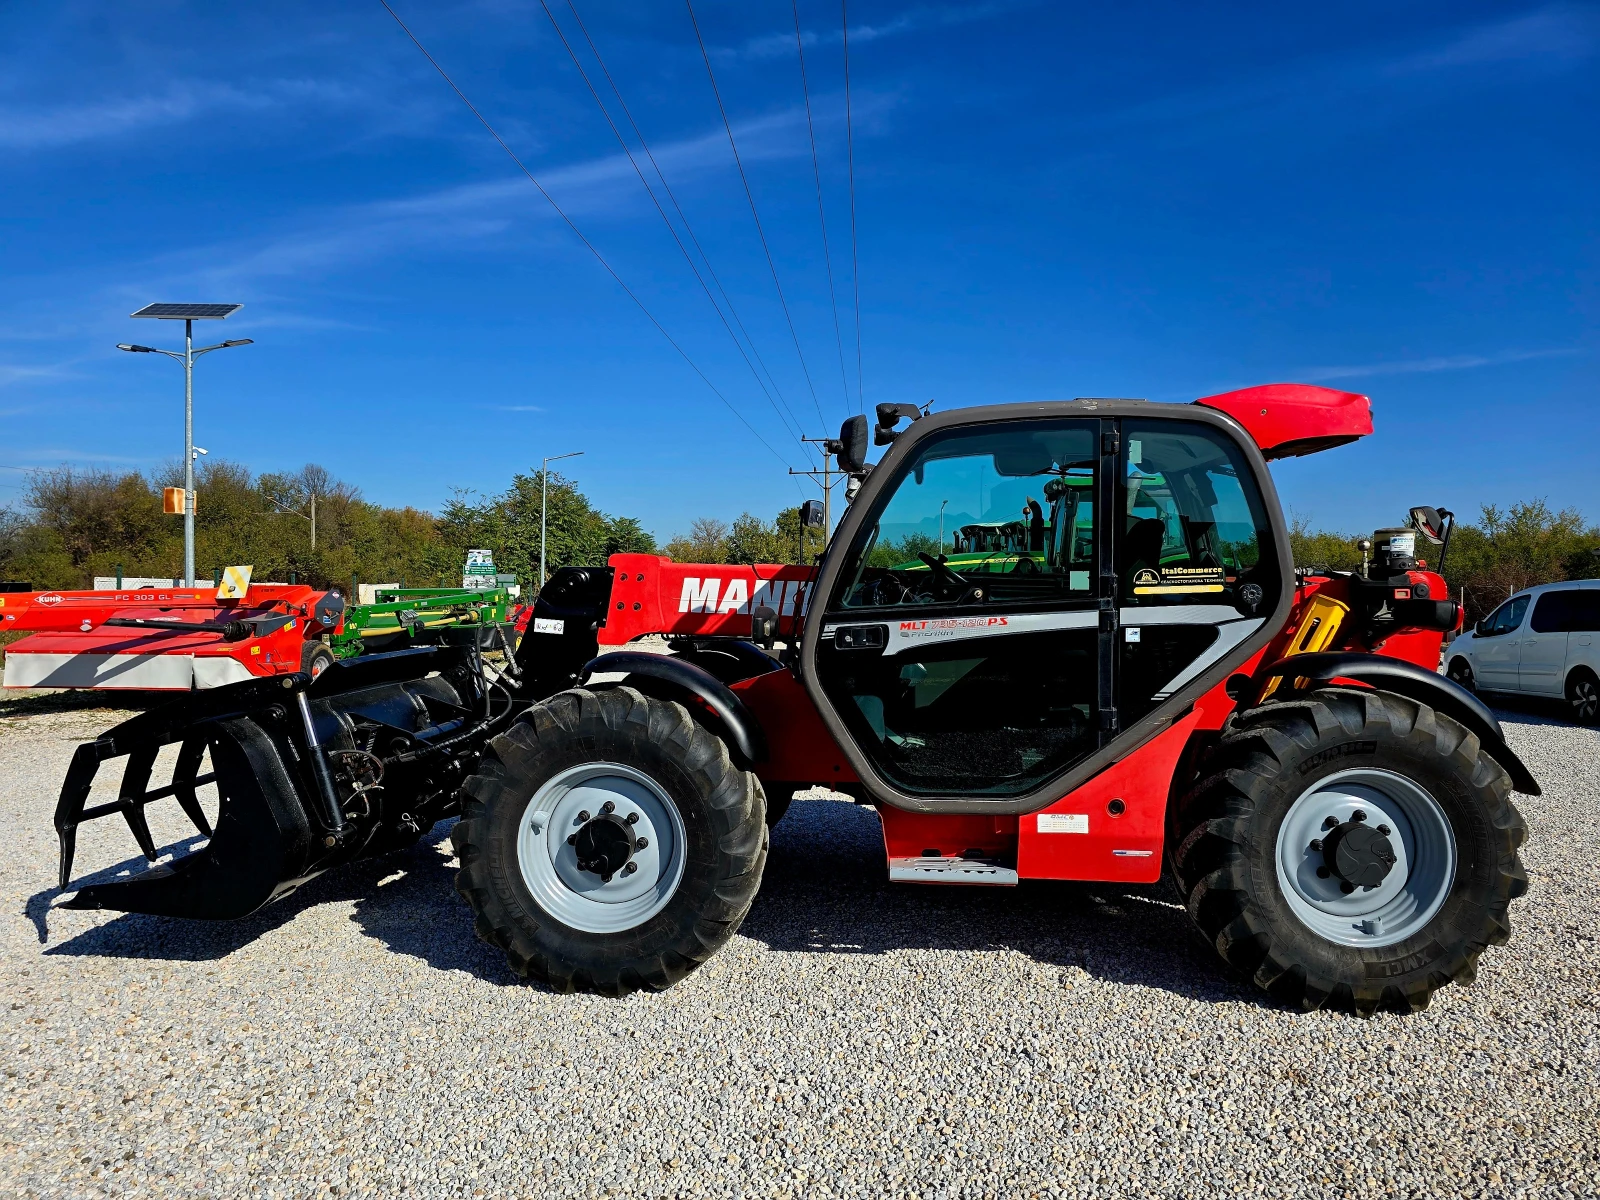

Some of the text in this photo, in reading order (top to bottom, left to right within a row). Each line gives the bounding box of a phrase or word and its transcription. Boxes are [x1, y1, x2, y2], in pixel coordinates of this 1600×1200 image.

[1161, 567, 1223, 575] ItalCommerce
[39, 595, 61, 603] KUHN
[900, 617, 1008, 630] MLT 735-120 PS
[1380, 949, 1433, 976] XMCL
